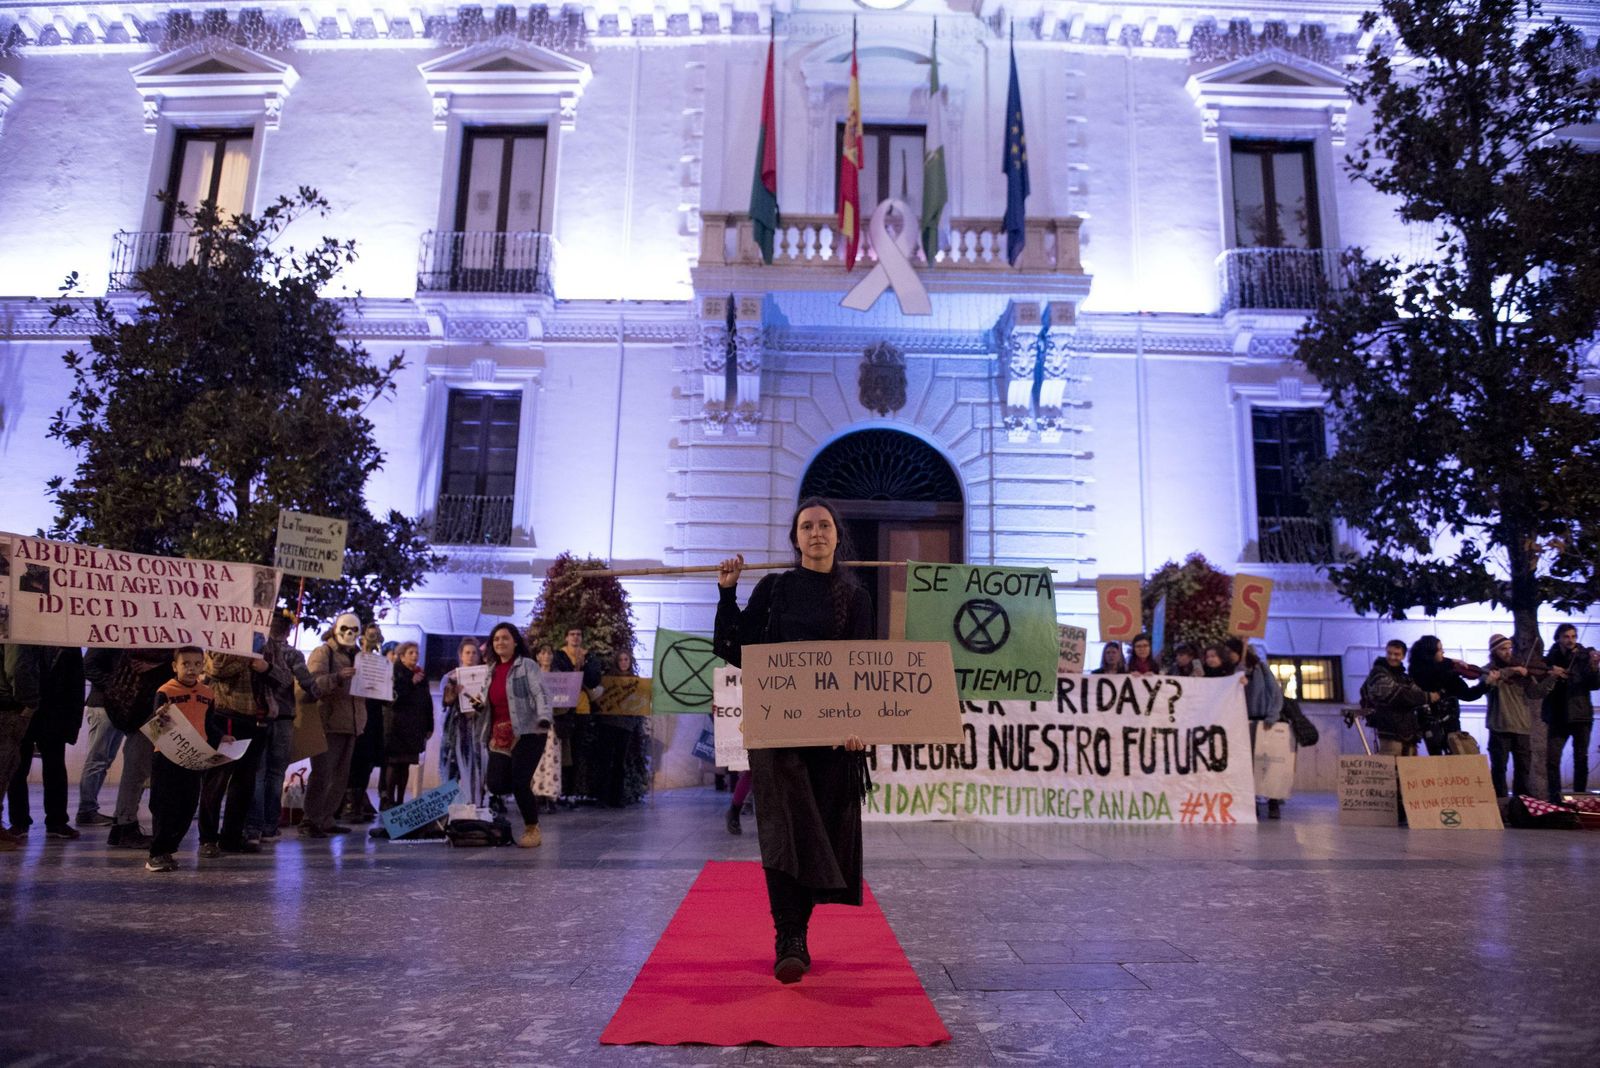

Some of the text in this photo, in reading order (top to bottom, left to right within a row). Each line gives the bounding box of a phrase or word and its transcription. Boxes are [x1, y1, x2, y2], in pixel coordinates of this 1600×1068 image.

[15, 539, 234, 582] ABUELAS CONTRA
[280, 542, 338, 561] PERTENECEMOS
[285, 557, 294, 569] LA
[298, 559, 324, 574] TIERRA
[913, 565, 1052, 600] SE AGOTA
[153, 601, 186, 619] LA
[1106, 588, 1133, 635] S
[1237, 584, 1264, 631] S
[87, 624, 193, 645] ACTUAD
[768, 651, 926, 668] NUESTRO ESTILO DE
[725, 675, 742, 686] M
[758, 671, 932, 694] VIDA HA MUERTO
[761, 701, 912, 720] Y NO siento dolor
[891, 723, 978, 772] NEGRO
[988, 723, 1111, 776] NUESTRO
[1122, 724, 1228, 776] FUTURO
[1421, 777, 1436, 788] UN
[1437, 775, 1470, 788] GRADO
[867, 782, 1237, 823] RIDAYSFORFUTUREGRANADA #XR
